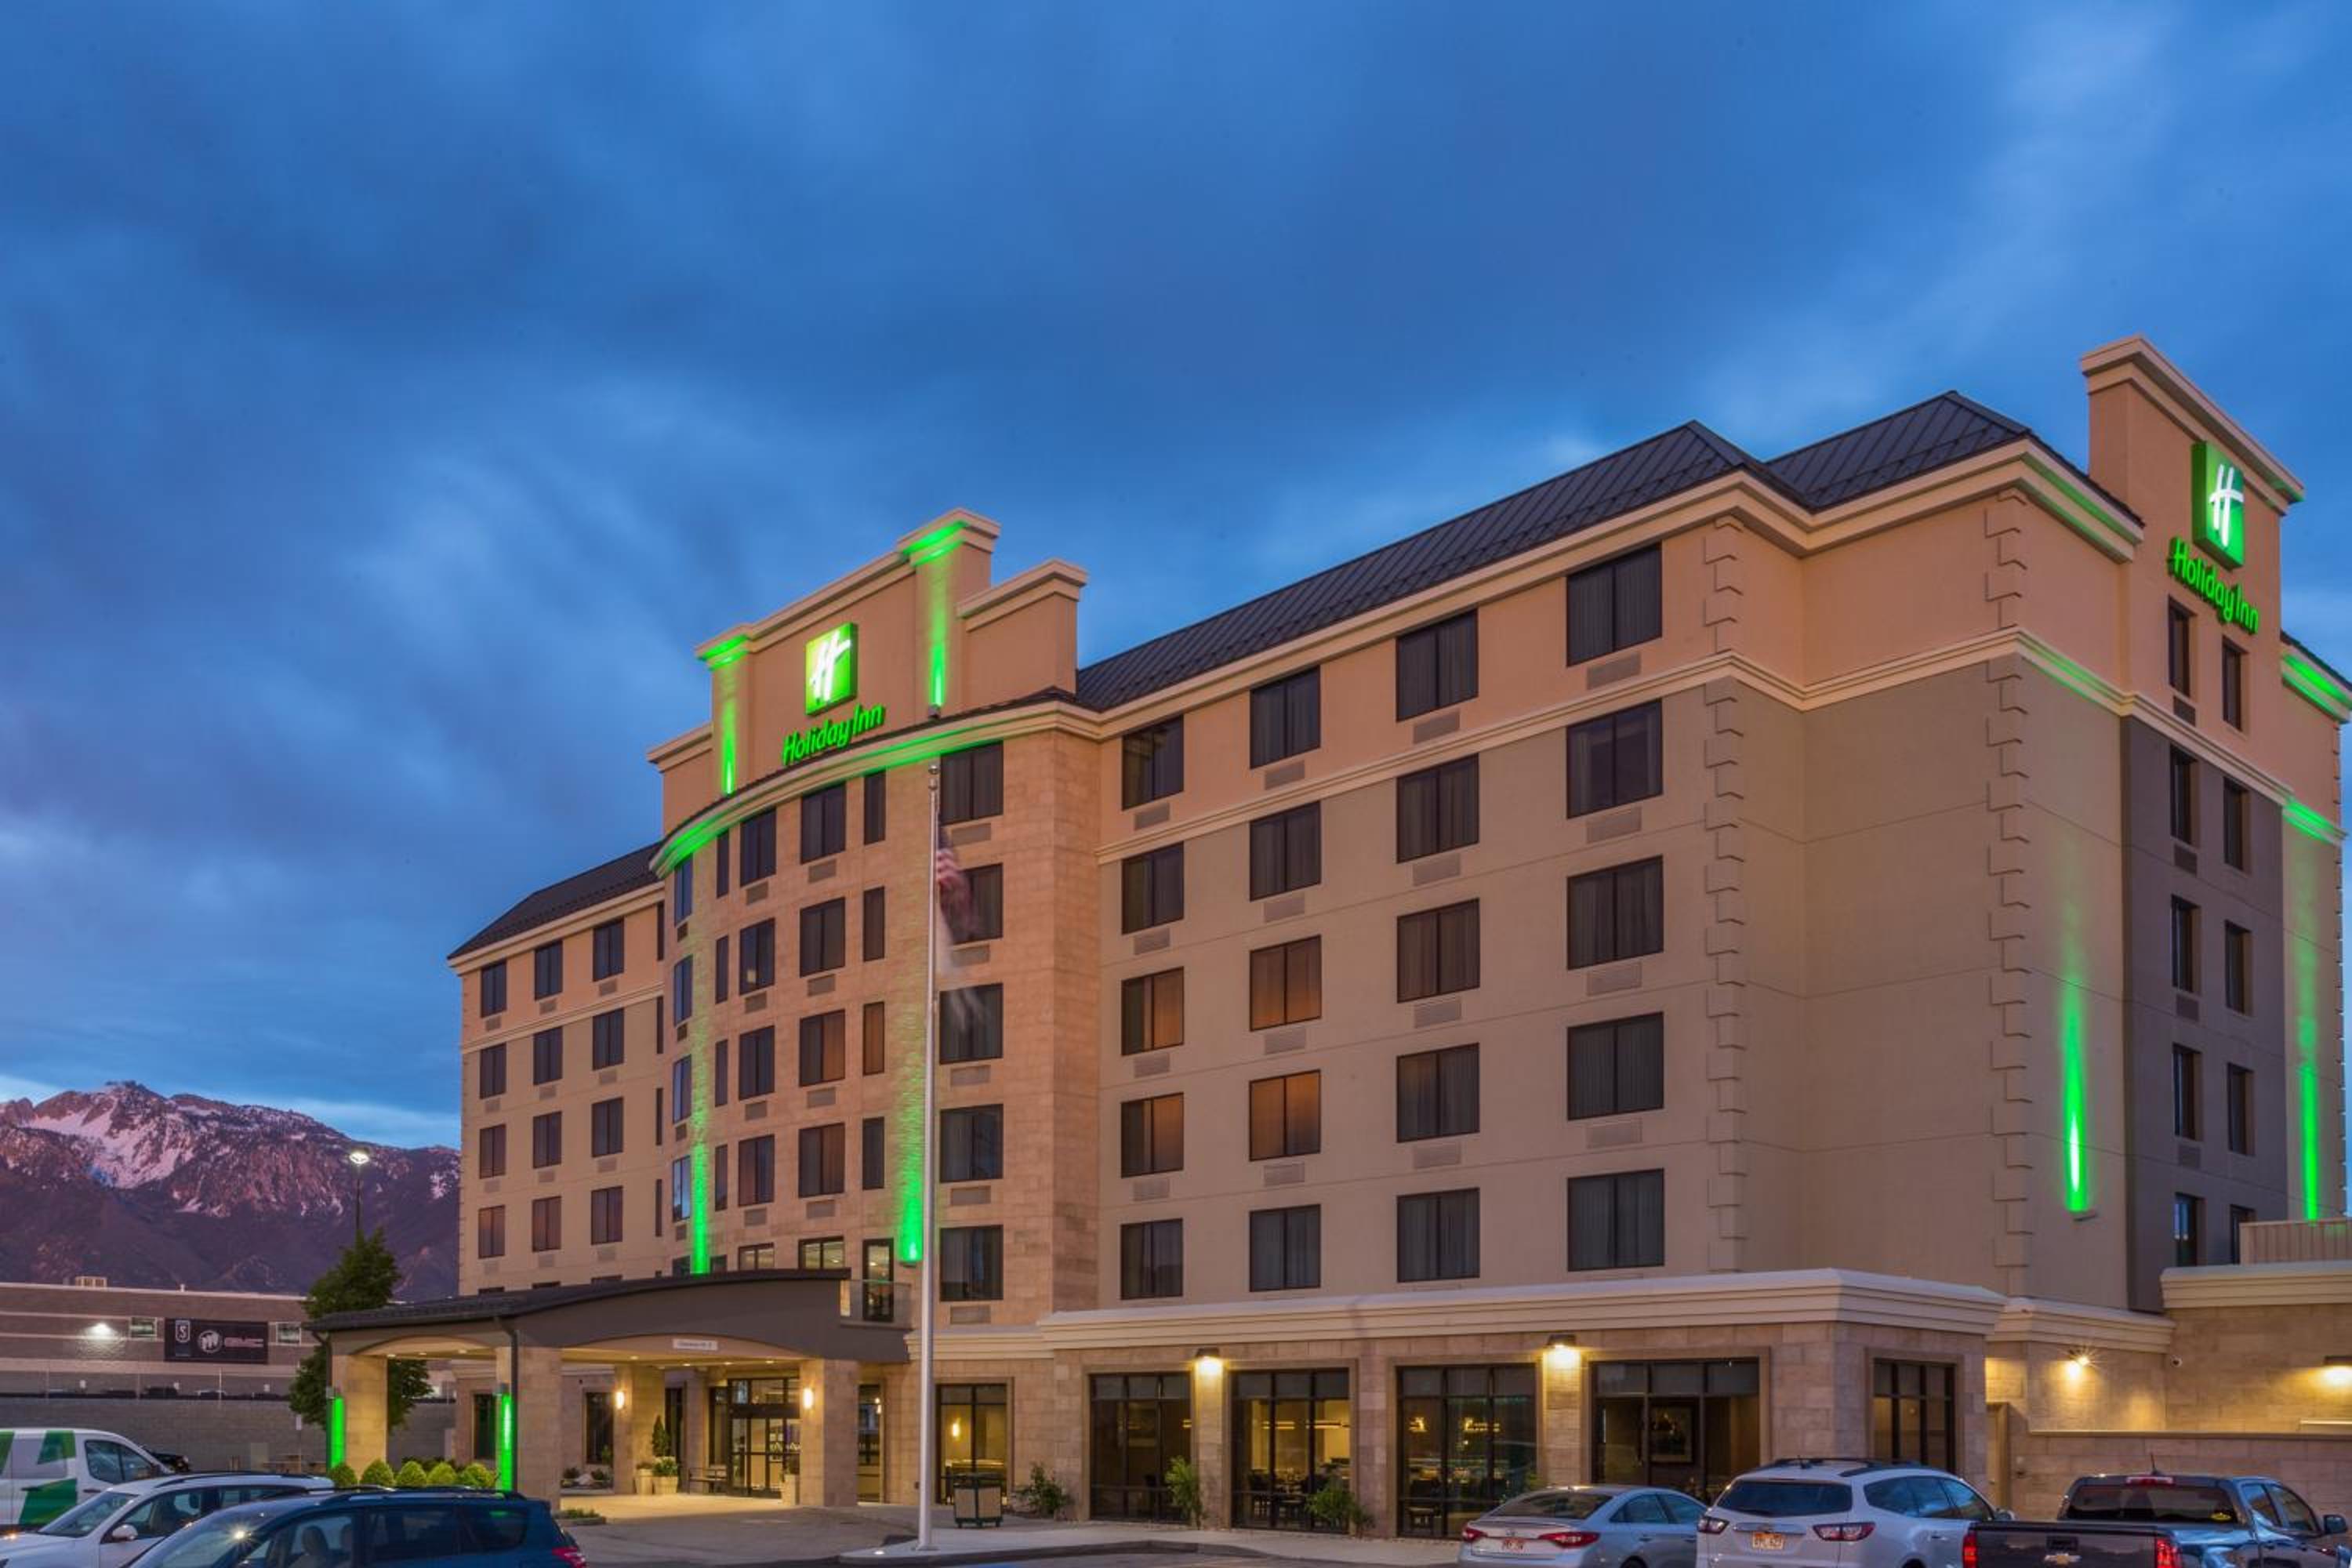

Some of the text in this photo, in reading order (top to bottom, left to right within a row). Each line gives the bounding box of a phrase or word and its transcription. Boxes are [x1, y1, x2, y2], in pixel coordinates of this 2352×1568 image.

[2169, 537, 2259, 634] Holiday Inn
[782, 704, 885, 767] Holiday Inn
